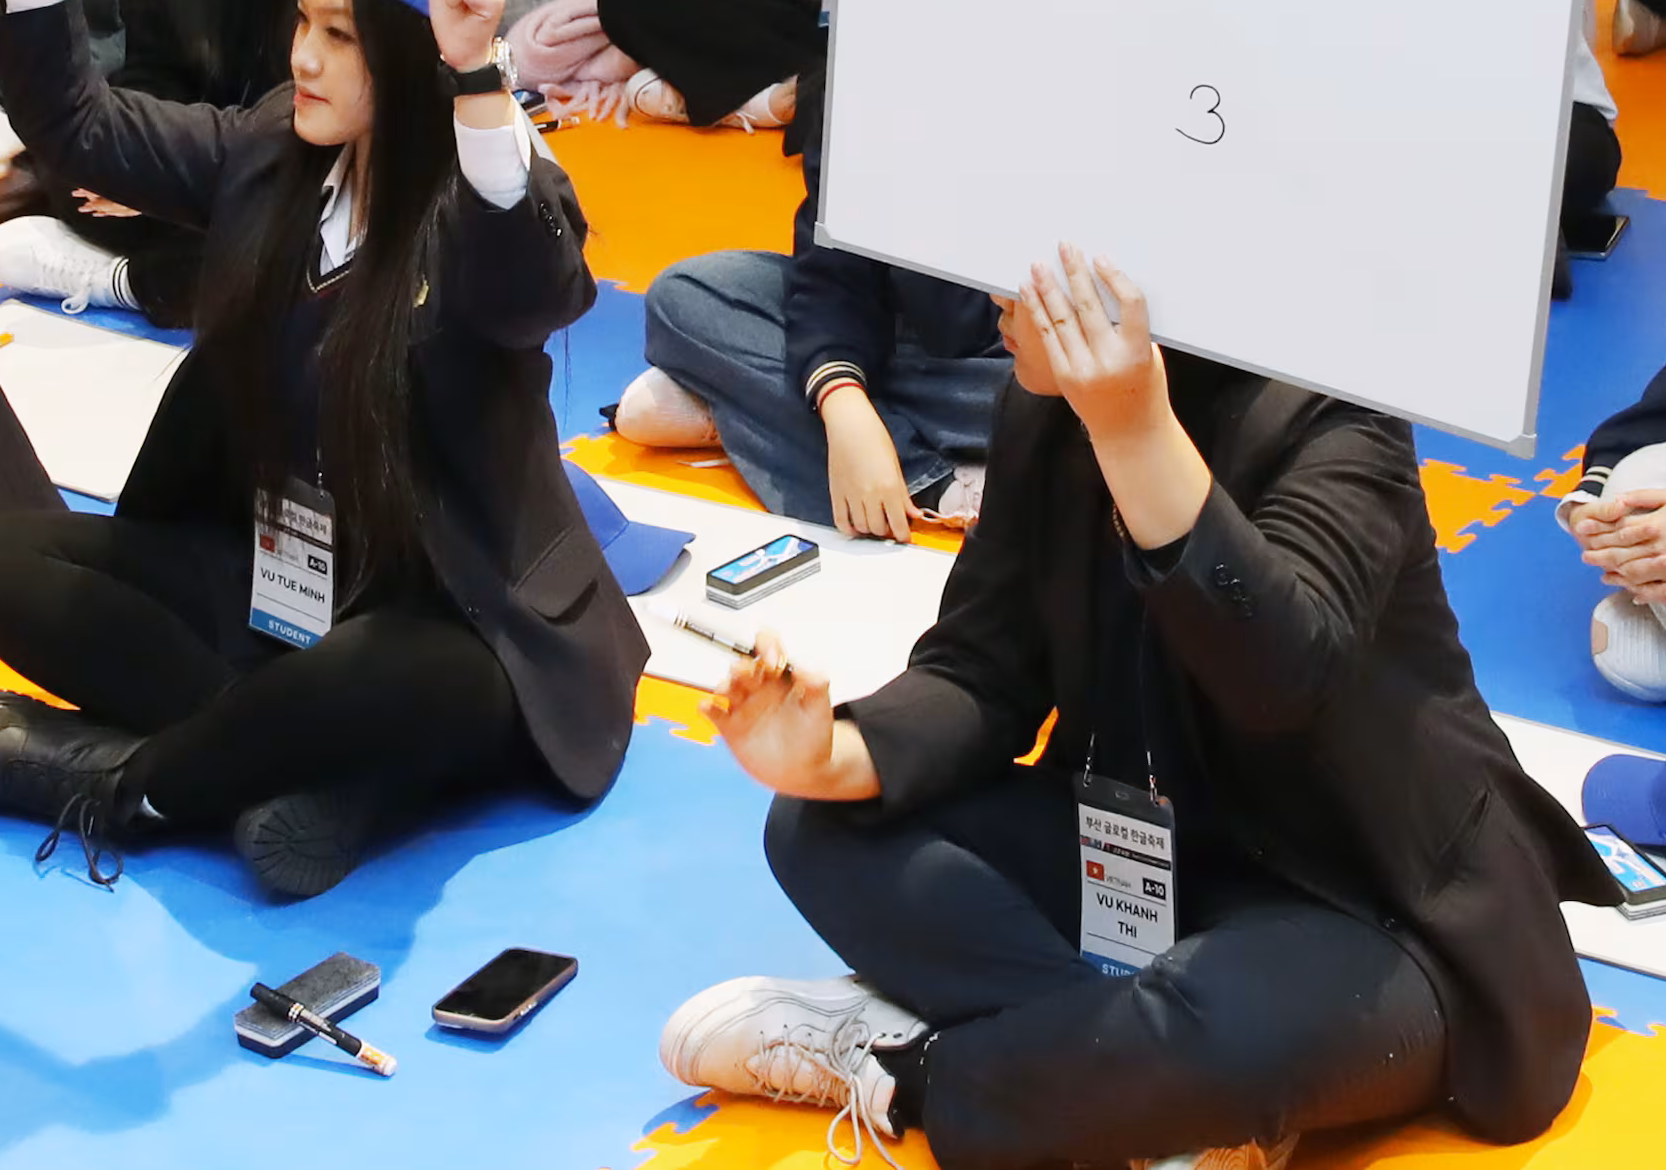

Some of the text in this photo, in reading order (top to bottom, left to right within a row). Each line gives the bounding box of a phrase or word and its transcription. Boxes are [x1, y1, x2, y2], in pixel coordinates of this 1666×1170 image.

[1175, 84, 1226, 145] 3
[260, 567, 325, 603] VU TUE MINH
[268, 619, 312, 645] STUDENT
[1085, 815, 1165, 851] 부산 글로컬 한글축제
[1144, 882, 1165, 897] A-10
[1096, 892, 1158, 923] VU KHANH
[1118, 921, 1137, 939] THI
